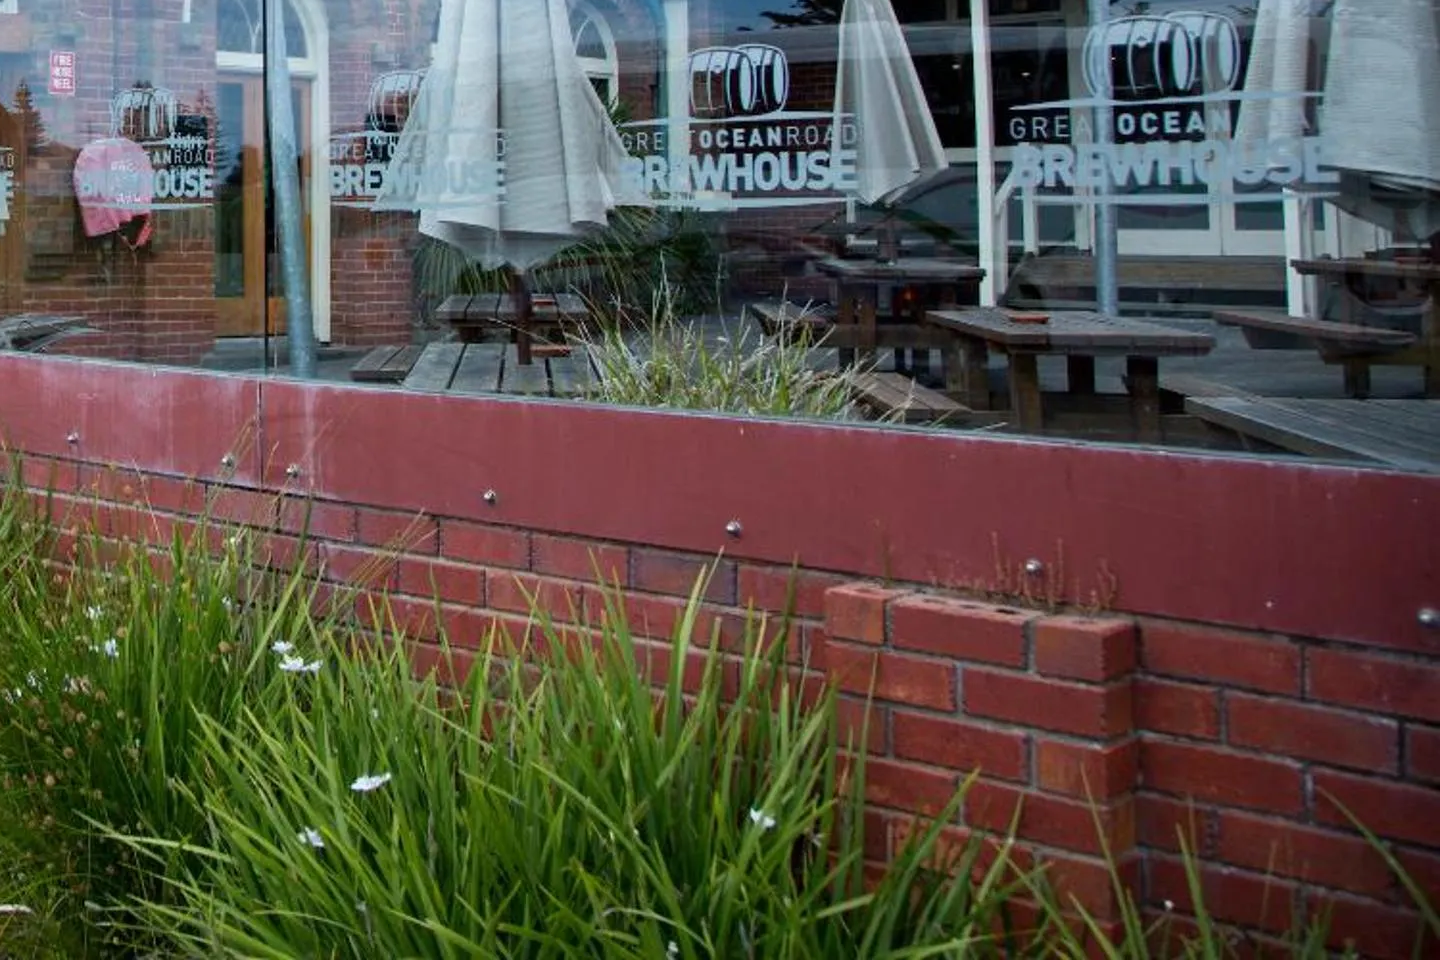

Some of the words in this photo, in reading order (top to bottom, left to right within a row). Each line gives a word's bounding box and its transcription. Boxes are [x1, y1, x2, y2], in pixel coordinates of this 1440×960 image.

[1009, 115, 1100, 139] GREA
[618, 149, 858, 191] RWHOUSE
[1012, 136, 1341, 188] BREWHOUSE
